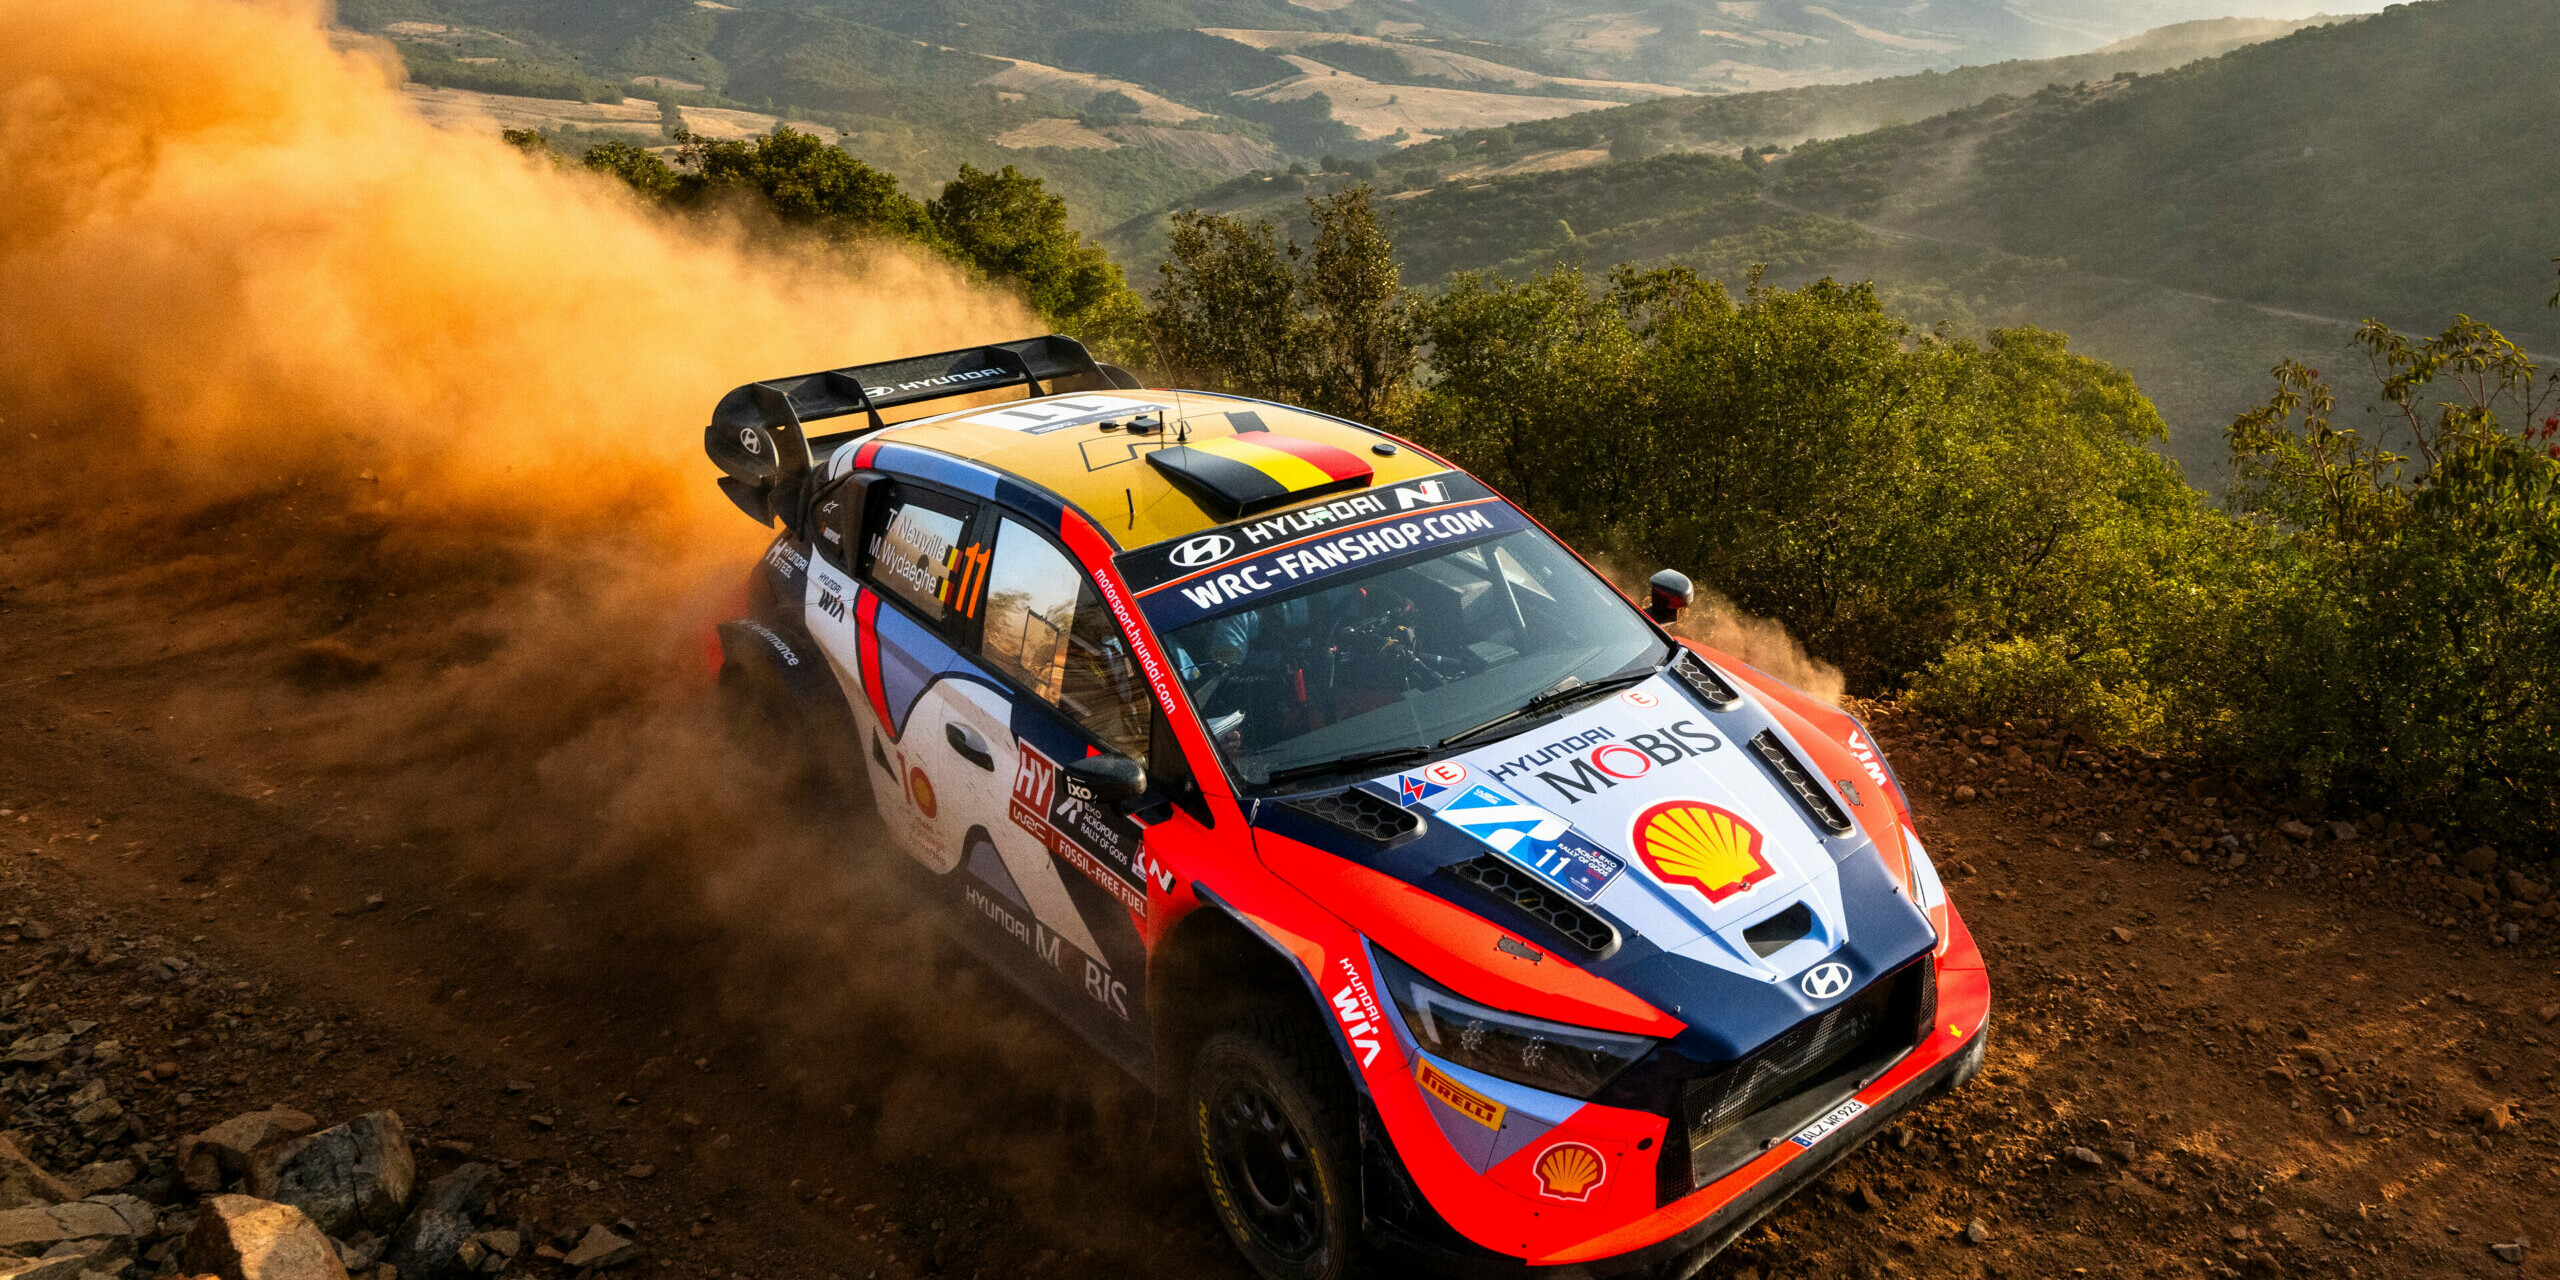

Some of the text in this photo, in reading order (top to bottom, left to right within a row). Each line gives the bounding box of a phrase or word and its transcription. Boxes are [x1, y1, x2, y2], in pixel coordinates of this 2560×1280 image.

[898, 367, 1006, 391] HYUNDAI
[886, 508, 947, 563] T. Neuville
[1241, 494, 1386, 544] HYUNDAI
[774, 557, 794, 579] STEEL
[781, 545, 809, 572] HYUNDAI
[818, 572, 843, 594] HYUNDAI
[868, 533, 882, 560] M.
[882, 541, 937, 594] Wydaeghe
[955, 542, 991, 619] 11
[1181, 509, 1494, 609] WRC-FANSHOP.COM
[818, 588, 845, 623] WIA
[1094, 568, 1176, 715] motorsport.hyundai.com
[1016, 751, 1051, 806] HY
[1487, 726, 1616, 782] HYUNDAI
[1535, 720, 1722, 805] MOBIS
[1848, 730, 1887, 786] WIA
[1083, 812, 1119, 844] ACROPOLIS
[1084, 802, 1102, 819] EKO
[1080, 822, 1128, 866] RALLY OF GODS
[1534, 848, 1572, 878] 11
[1557, 843, 1581, 858] RALLY
[1587, 862, 1610, 878] GODS
[1574, 847, 1615, 874] ACROPOLIS
[1598, 854, 1618, 869] EKO
[1059, 839, 1147, 918] FOSSIL-FREE FUEL
[966, 884, 1030, 946] HYUNDAI
[1035, 922, 1131, 1022] MBIS
[1339, 957, 1381, 1022] HYUNDAI
[1332, 985, 1382, 1070] WIA
[1421, 1065, 1498, 1123] PIRELLI
[1802, 1101, 1863, 1141] ALZ WR 923
